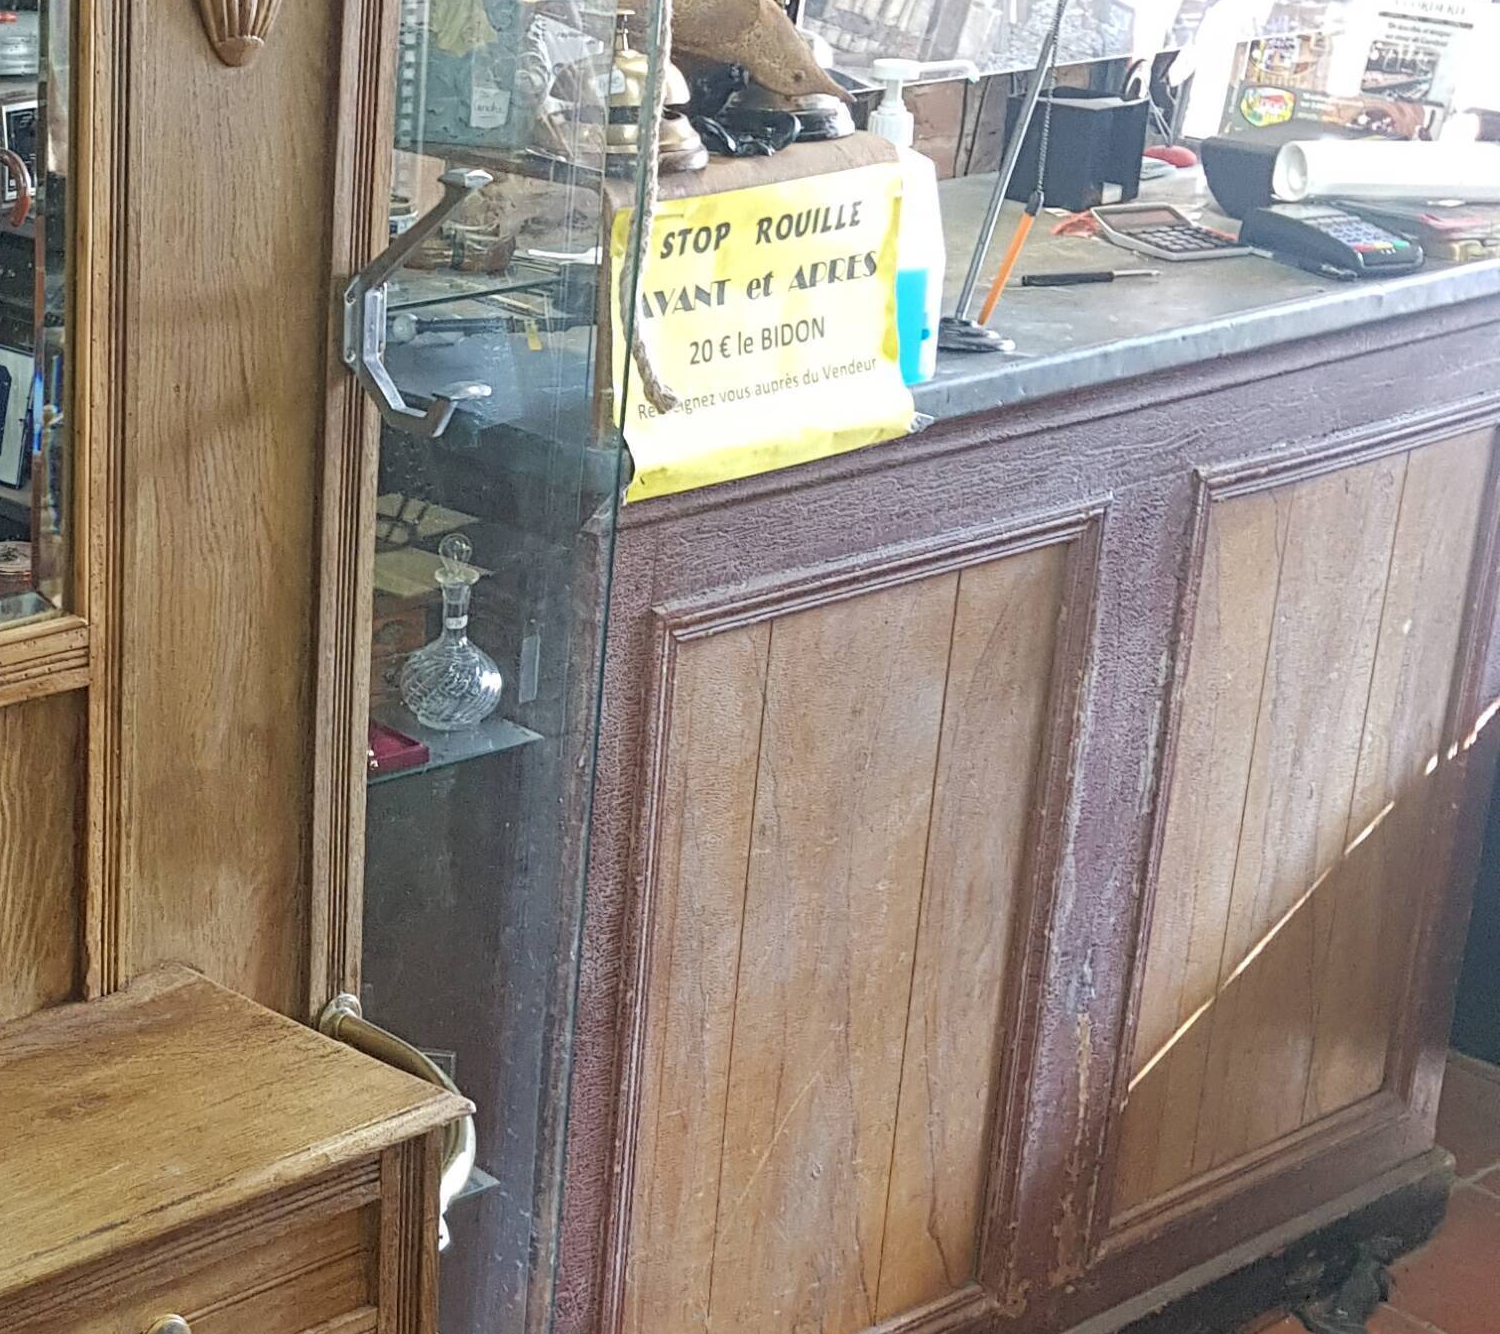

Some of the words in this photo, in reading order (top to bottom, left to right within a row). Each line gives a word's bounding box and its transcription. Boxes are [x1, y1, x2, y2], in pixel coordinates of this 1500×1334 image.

[660, 222, 731, 259] STOP
[755, 200, 863, 245] ROUILLE
[642, 278, 732, 319] AVANT
[746, 270, 774, 300] et
[788, 250, 878, 292] APRES
[689, 339, 714, 365] 20
[719, 335, 731, 359] €
[738, 330, 754, 356] le
[761, 316, 825, 351] BIDON
[638, 394, 716, 420] Reignez
[720, 385, 752, 404] vous
[754, 373, 799, 400] auprès
[803, 368, 819, 385] du
[822, 356, 877, 380] Vendeur
